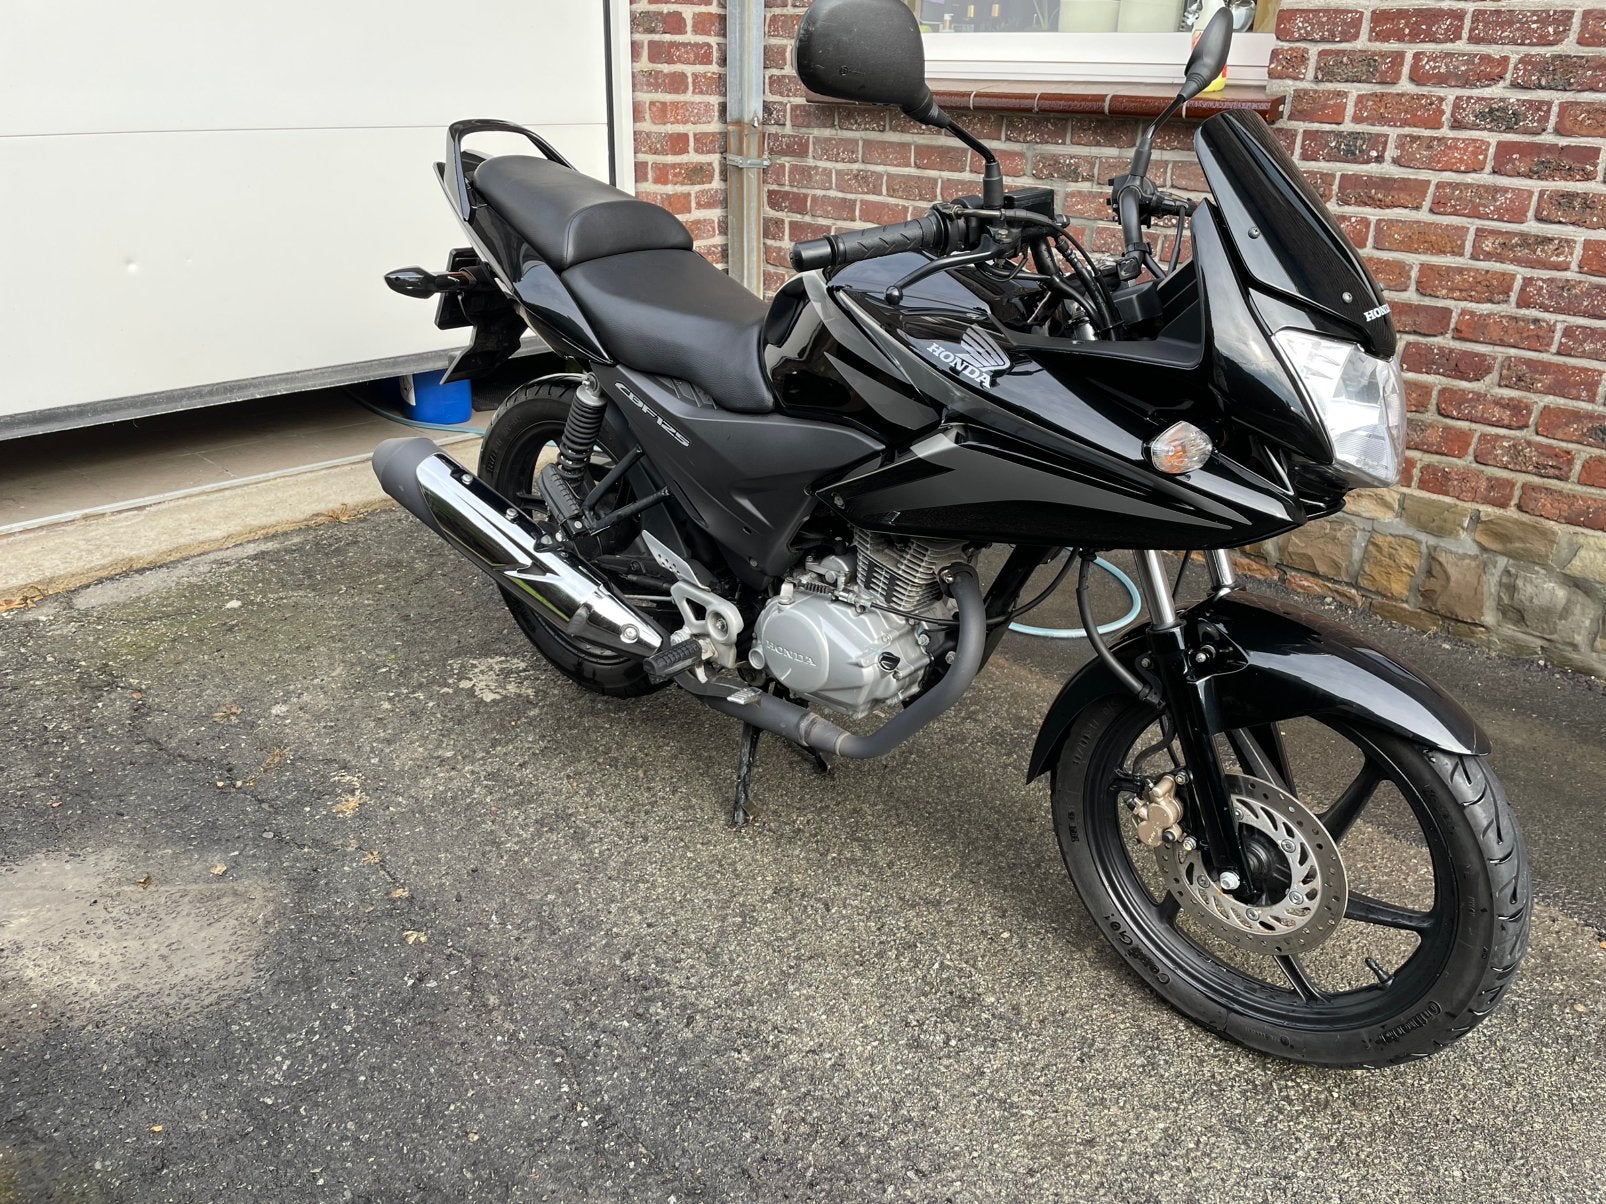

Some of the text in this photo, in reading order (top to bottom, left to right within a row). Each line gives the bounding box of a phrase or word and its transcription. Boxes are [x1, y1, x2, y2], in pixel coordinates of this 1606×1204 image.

[926, 342, 991, 389] HONDA
[614, 382, 690, 447] CBF125
[765, 639, 817, 667] HONDA
